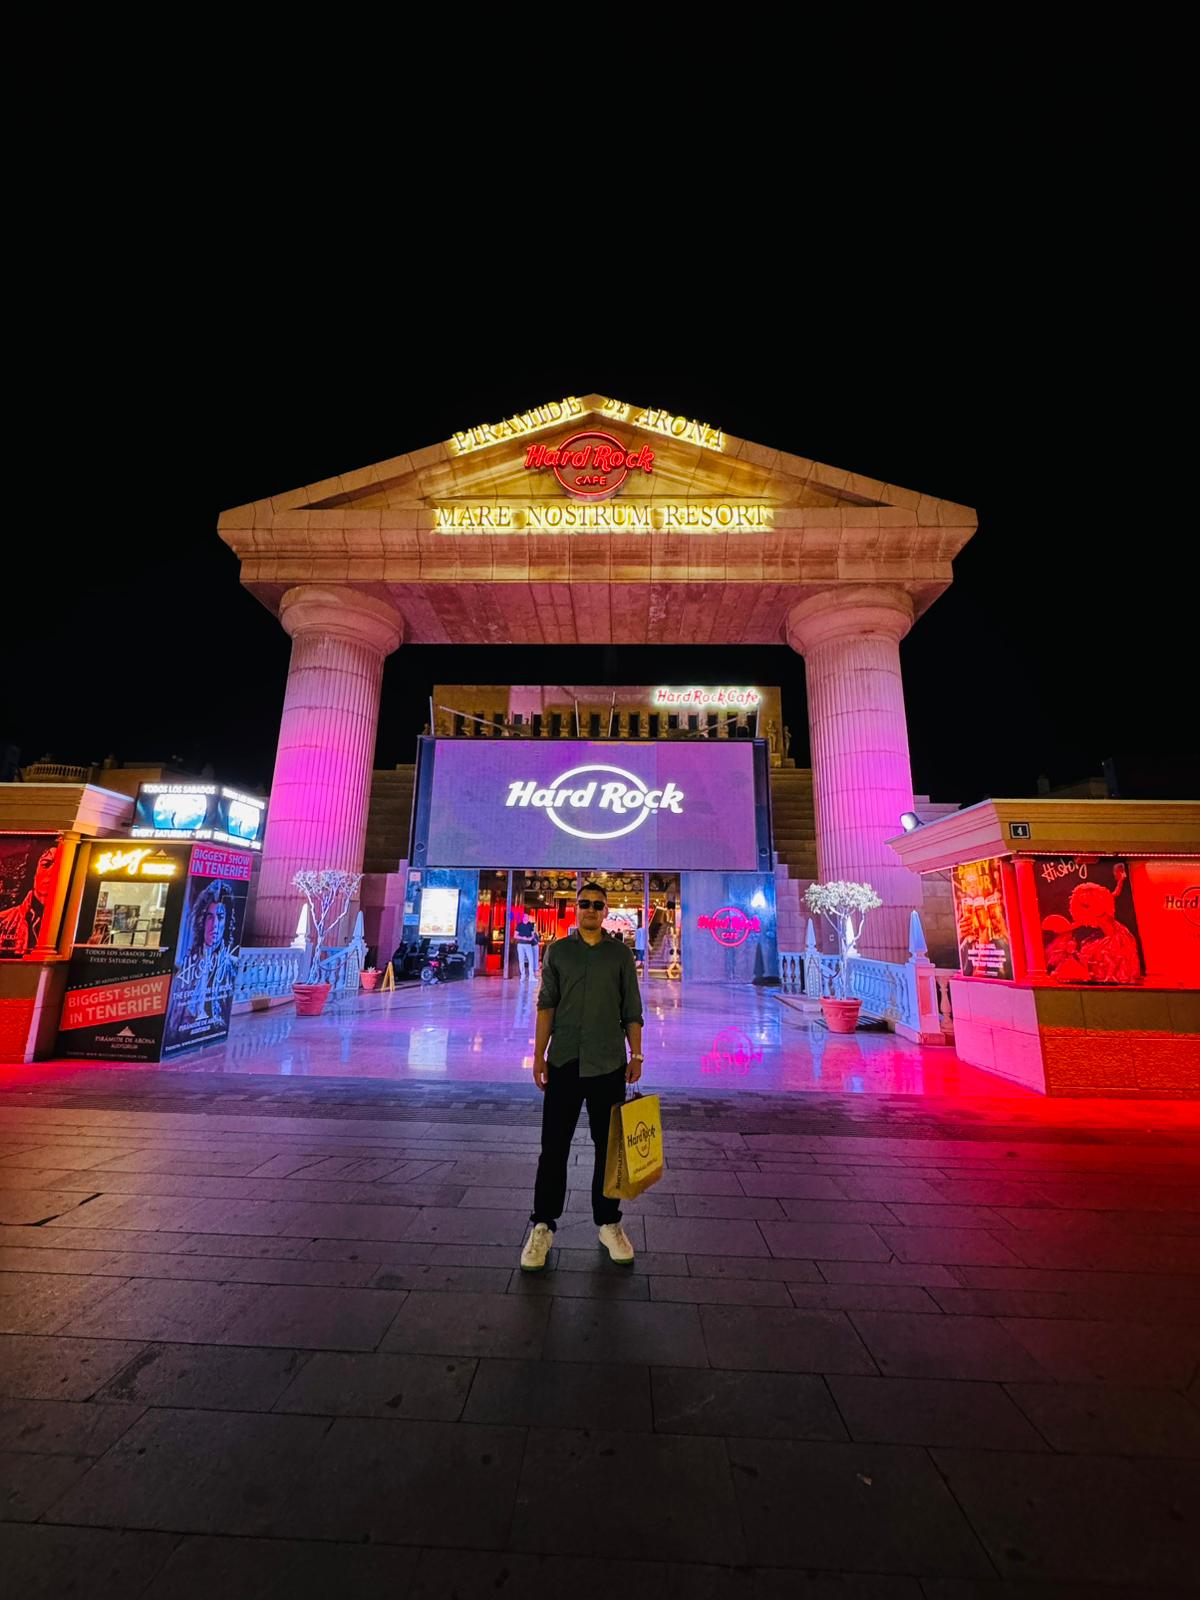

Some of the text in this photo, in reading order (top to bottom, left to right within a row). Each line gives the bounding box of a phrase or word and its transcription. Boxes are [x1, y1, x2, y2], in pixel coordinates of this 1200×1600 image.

[453, 396, 725, 452] PIRAMIDE DE ARONA
[525, 444, 655, 473] Hard Rock
[575, 476, 607, 486] CAFE
[436, 504, 768, 527] MARE NOSTRUM RESORT
[656, 688, 760, 705] Hard Rock Cafe
[505, 781, 685, 814] Hard Rock
[194, 848, 250, 866] BIGGEST SHOW
[191, 860, 203, 873] IN
[205, 861, 249, 878] TENERIFE
[1165, 895, 1199, 909] Hard
[697, 915, 761, 932] Hard Rock
[68, 989, 121, 1008] BIGGEST
[123, 982, 164, 998] SHOW
[70, 1012, 83, 1025] IN
[86, 996, 163, 1021] TENERIFE
[627, 1130, 643, 1148] Hard
